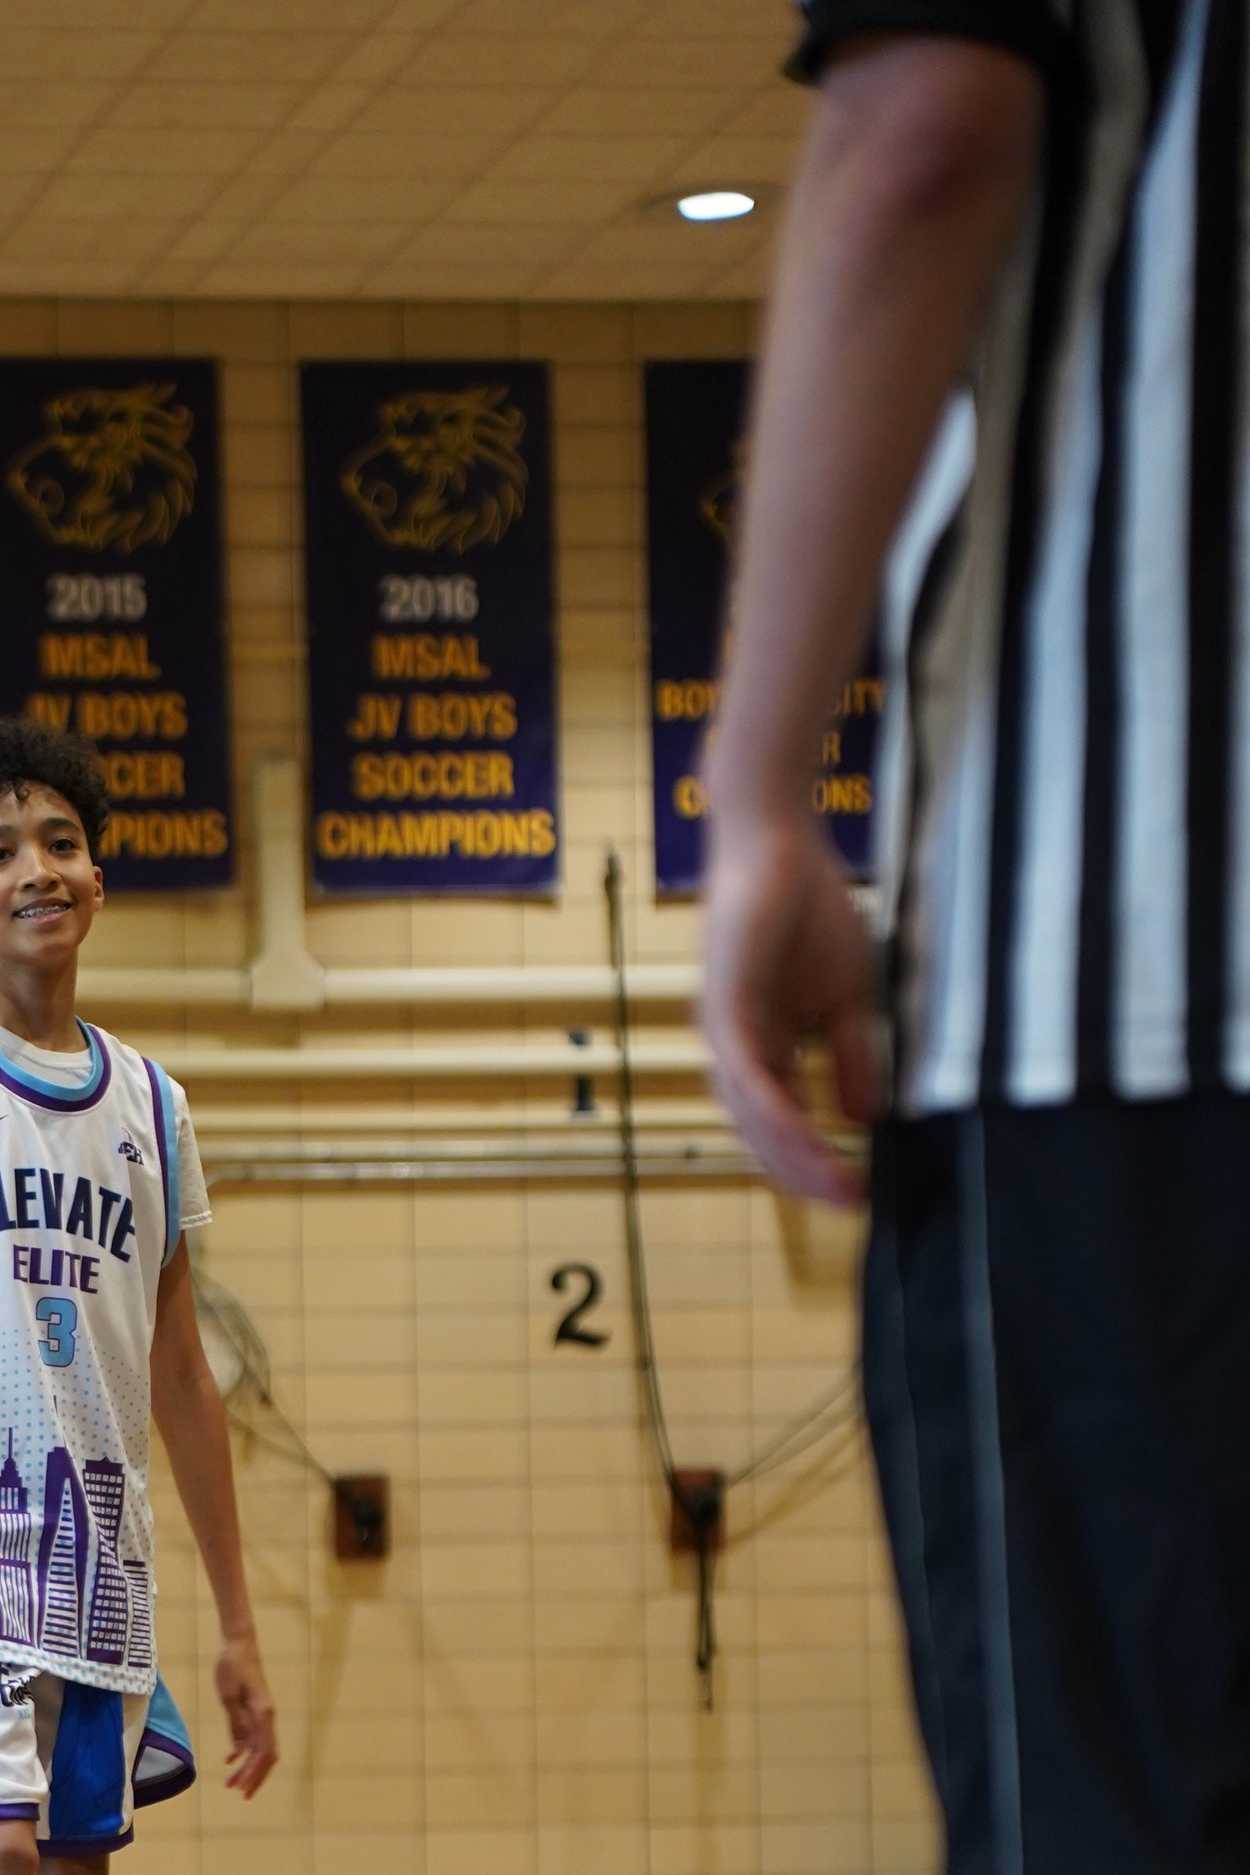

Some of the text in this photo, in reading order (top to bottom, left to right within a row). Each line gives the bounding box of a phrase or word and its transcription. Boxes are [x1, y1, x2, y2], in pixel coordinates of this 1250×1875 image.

[50, 575, 147, 620] 2015
[381, 576, 479, 621] 2016
[40, 634, 161, 680] MSAL
[372, 634, 491, 680] MSAL
[78, 693, 187, 739] BOYS
[349, 693, 517, 739] JV BOYS
[354, 753, 514, 798] SOCCER
[318, 810, 556, 858] CHAMPIONS
[13, 1244, 100, 1294] ELITE
[551, 1262, 610, 1350] 2
[35, 1297, 78, 1367] 3
